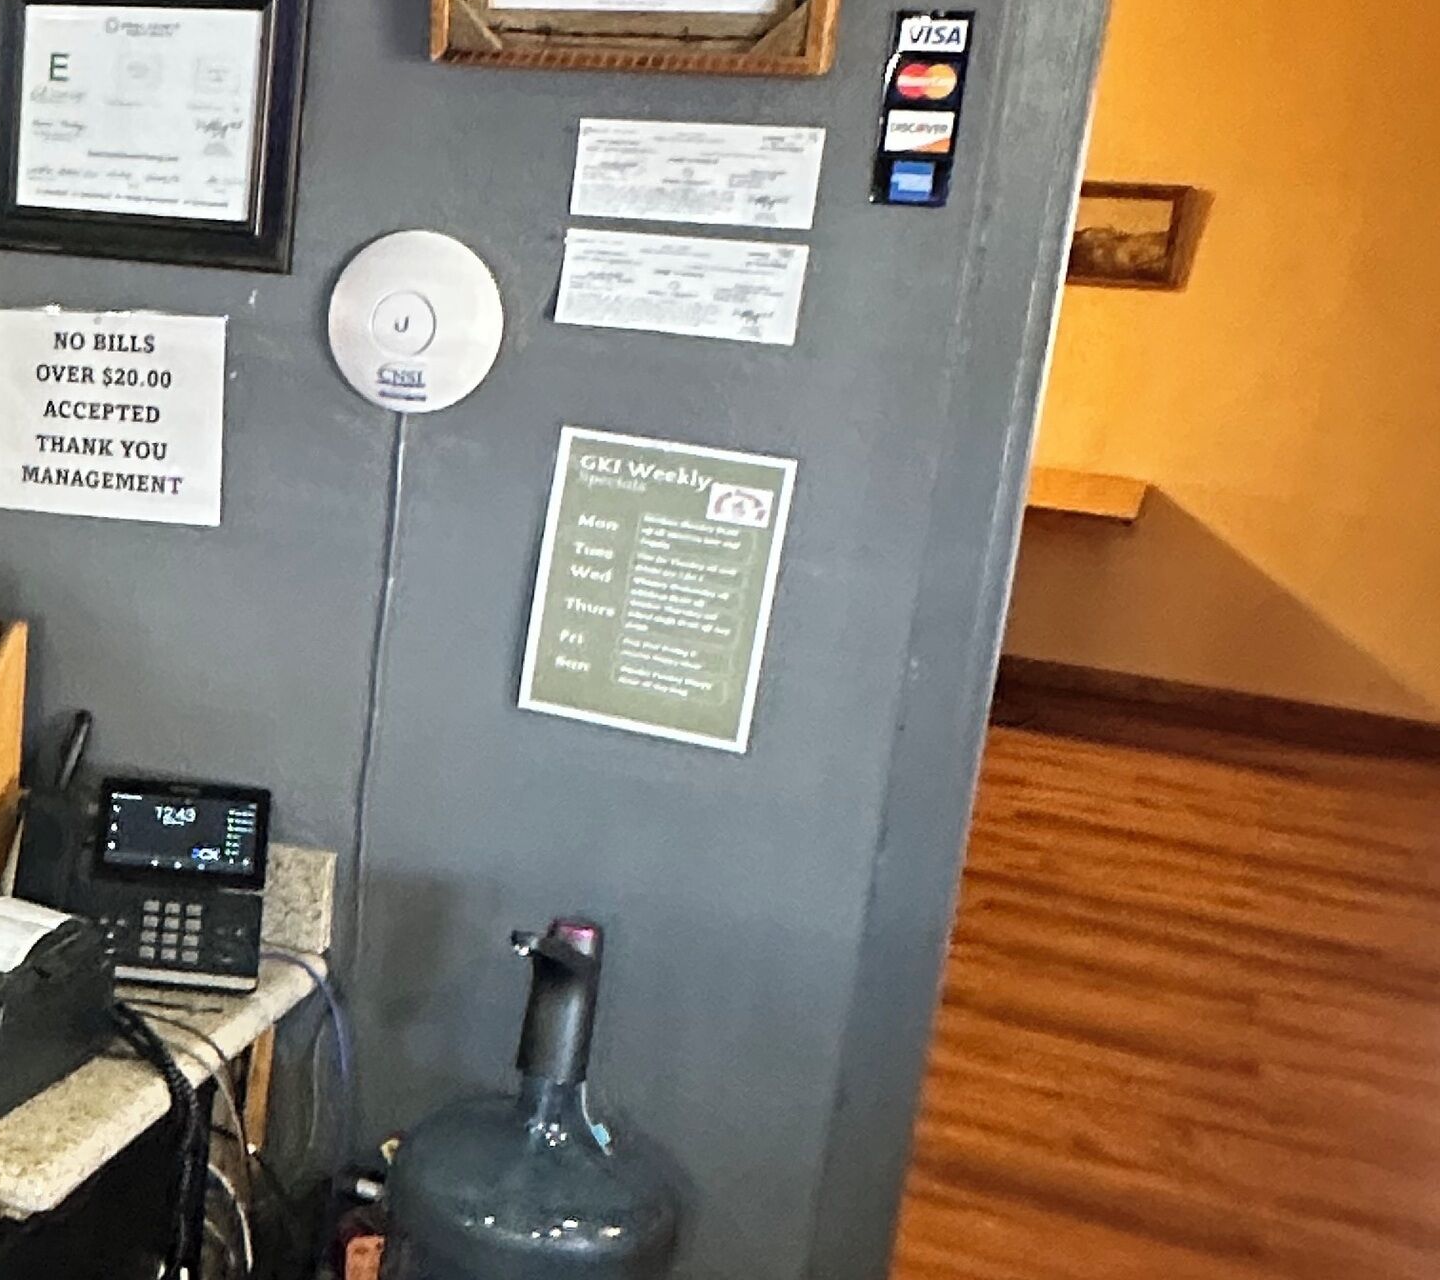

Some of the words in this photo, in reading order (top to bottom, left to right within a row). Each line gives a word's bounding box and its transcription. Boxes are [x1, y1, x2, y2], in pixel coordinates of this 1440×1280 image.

[910, 24, 961, 46] VISA
[53, 332, 85, 350] NO
[94, 333, 155, 353] BILLS
[36, 364, 95, 384] OVER
[103, 368, 172, 388] $20.00
[43, 400, 160, 423] ACCEPTED
[36, 434, 113, 457] THANK
[121, 440, 168, 460] YOU
[21, 465, 183, 495] MANAGEMENT
[628, 460, 714, 493] Weekly
[577, 513, 619, 531] Mon
[572, 540, 614, 560] Tues
[569, 563, 614, 584] Wed
[564, 596, 616, 618] Thurs
